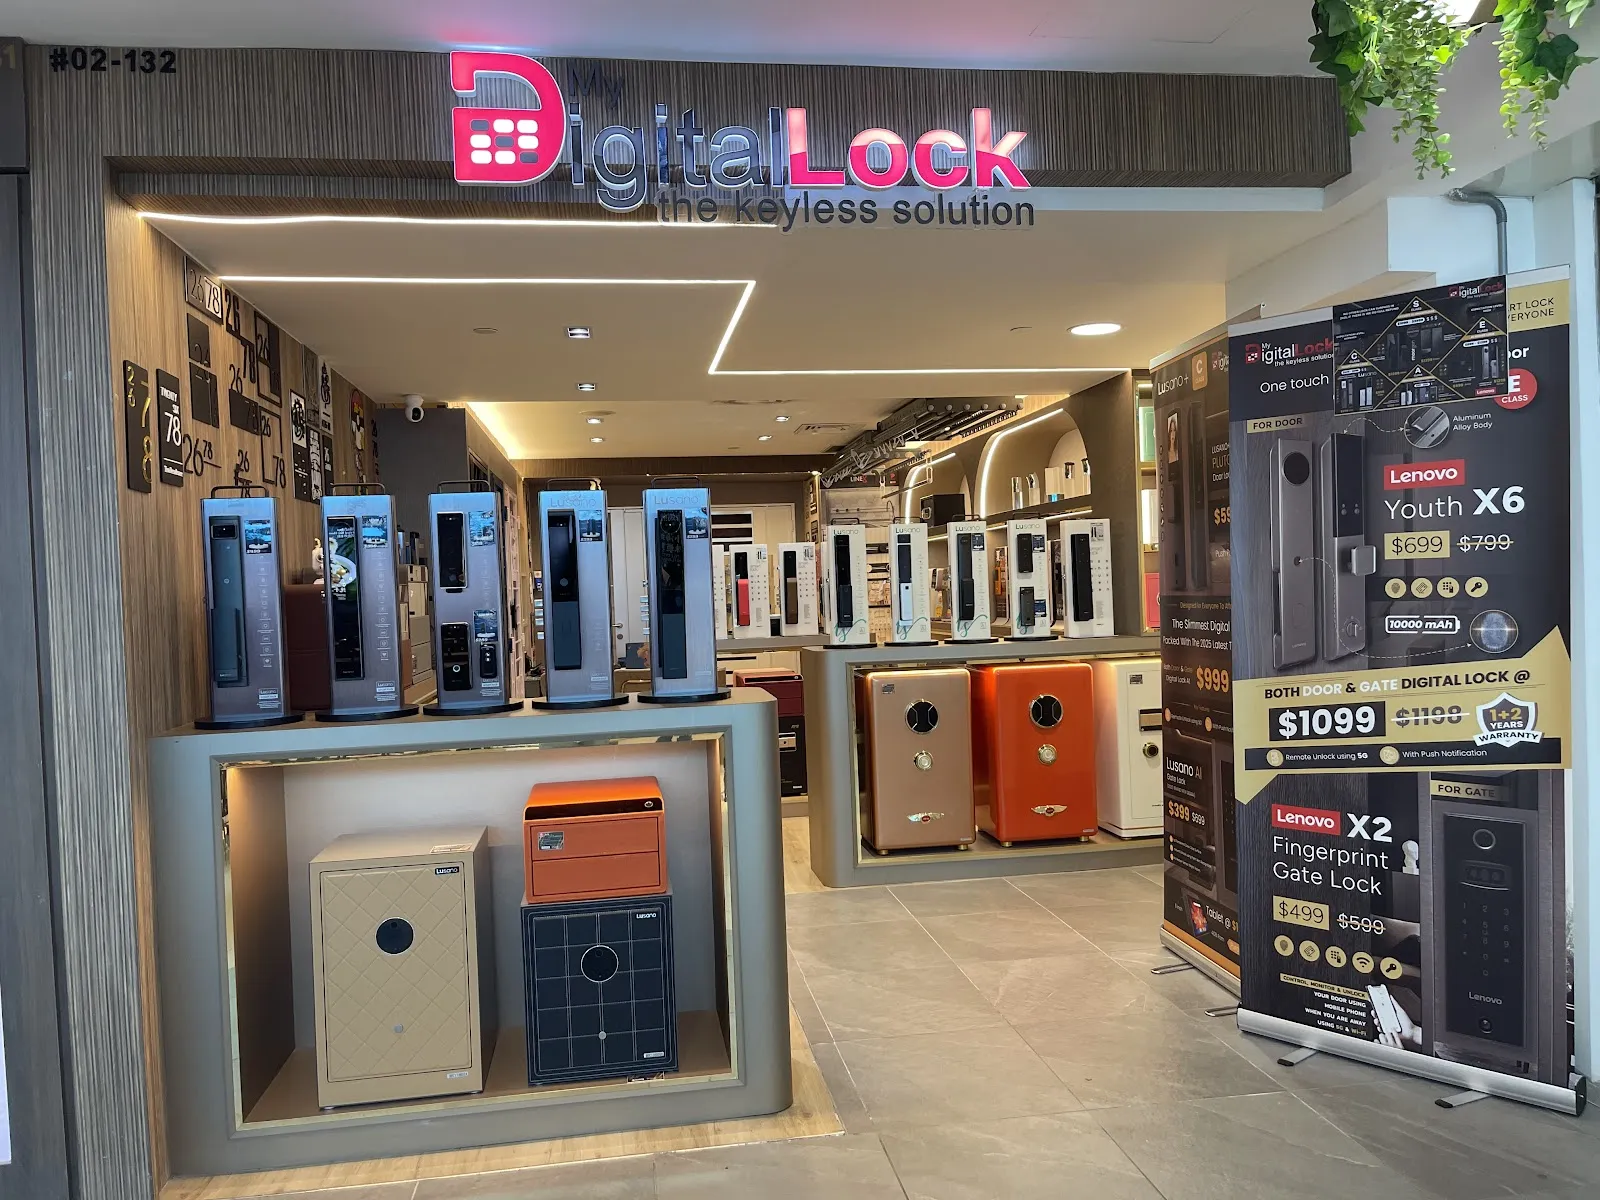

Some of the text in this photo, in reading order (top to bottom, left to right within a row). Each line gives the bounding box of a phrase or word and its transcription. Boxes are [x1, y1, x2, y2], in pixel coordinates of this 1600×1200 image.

[50, 48, 176, 73] #02-132
[570, 65, 624, 108] My
[658, 191, 1035, 235] the keyless solution
[1508, 297, 1554, 311] RT LOCK
[1509, 347, 1529, 359] or
[1197, 360, 1203, 374] C
[1260, 374, 1329, 393] One touch
[1501, 394, 1528, 403] CLASS
[1253, 418, 1302, 430] FOR DOOR
[1453, 413, 1491, 422] Aluminum
[165, 411, 182, 447] 78
[1453, 422, 1492, 431] Alloy Body
[1390, 468, 1458, 483] Lenovo
[1384, 486, 1525, 520] Youth X6
[1392, 534, 1510, 555] $699 $799
[1172, 619, 1184, 629] The
[1211, 620, 1230, 635] Digital
[1390, 620, 1453, 629] 10000 mAh
[1163, 636, 1179, 646] Packed
[1213, 640, 1228, 650] Latest
[1196, 665, 1229, 693] $999
[1265, 670, 1530, 699] BOTH DOOR & GATE DIGITAL LOCK @
[1490, 707, 1522, 721] 1+2
[1279, 706, 1462, 740] $1099 $1198
[1490, 721, 1523, 729] YEARS
[1479, 731, 1538, 742] WARRANTY
[1337, 753, 1356, 761] using
[1166, 757, 1194, 777] Lusano
[1177, 776, 1186, 785] Lock
[1438, 785, 1495, 798] FOR GATE
[1169, 800, 1190, 822] $399
[1277, 809, 1392, 843] Lenovo X2
[1274, 836, 1388, 869] Fingerprint
[1273, 861, 1381, 895] Gate Lock
[1205, 905, 1224, 924] Tablet
[1225, 918, 1231, 929] @
[1279, 901, 1384, 935] $499 $599
[1311, 982, 1335, 990] MONITOR
[1343, 989, 1365, 998] UNLOCK
[1314, 991, 1366, 1008] YOUR DOOR USING
[1469, 992, 1502, 1005] Lenovo
[1325, 1003, 1366, 1017] MOBILE PHONE
[1317, 1020, 1335, 1028] USING
